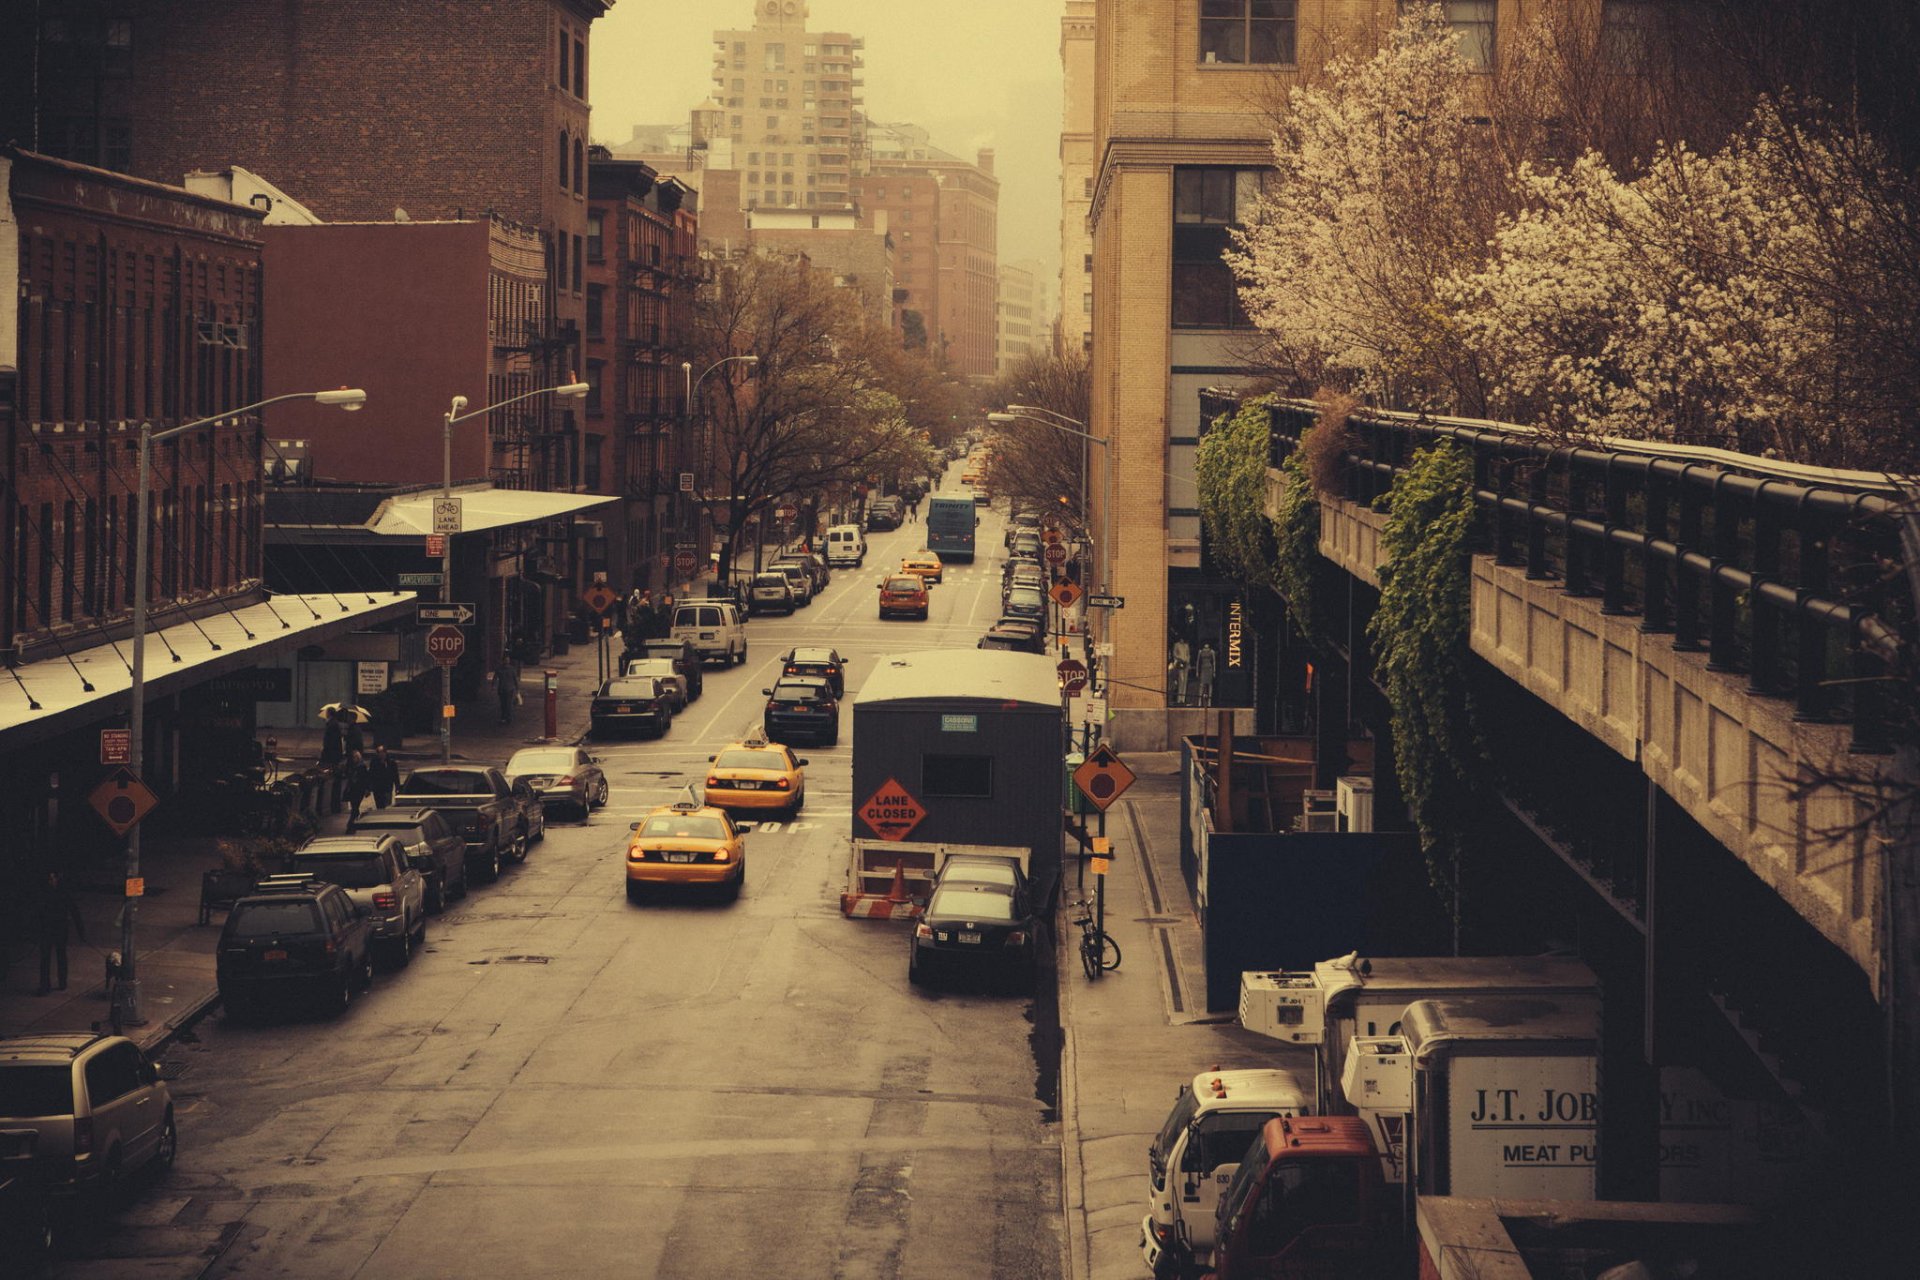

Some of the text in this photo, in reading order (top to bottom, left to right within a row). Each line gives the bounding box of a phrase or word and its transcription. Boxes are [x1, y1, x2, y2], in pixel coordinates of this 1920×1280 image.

[1046, 551, 1065, 559] STOP
[676, 557, 694, 567] STOP
[424, 610, 468, 618] ONE WAY
[1229, 602, 1241, 668] INTERMIX
[430, 637, 462, 651] STOP
[1057, 670, 1086, 683] STOP
[875, 796, 909, 806] LANE
[867, 808, 917, 819] CLOSED
[1471, 1089, 1526, 1121] J.T.
[1538, 1089, 1677, 1121] JOBY
[1503, 1145, 1561, 1162] MEAT
